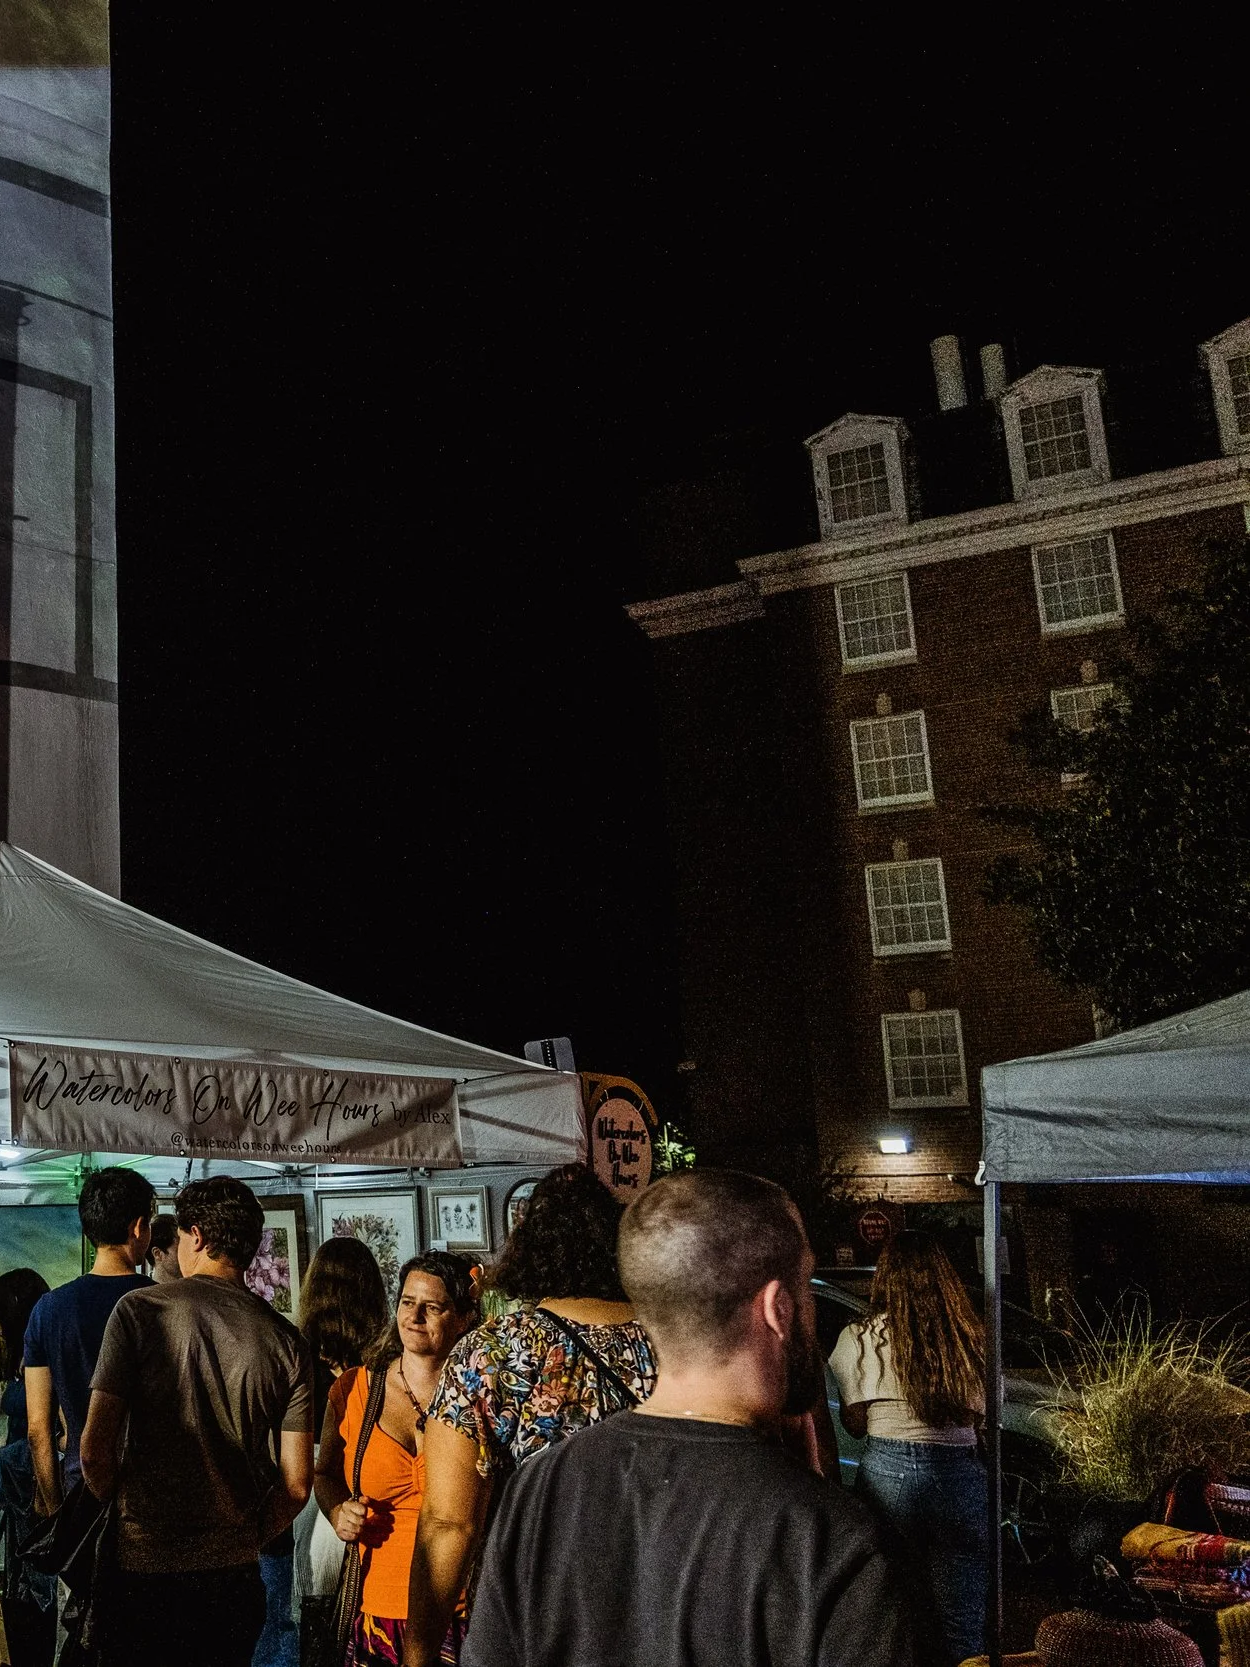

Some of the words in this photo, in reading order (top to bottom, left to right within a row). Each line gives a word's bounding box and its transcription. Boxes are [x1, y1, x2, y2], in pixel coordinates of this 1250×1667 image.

[23, 1057, 178, 1115] Watercolors
[193, 1075, 231, 1125] On
[243, 1074, 300, 1126] Wee
[310, 1078, 382, 1140] Hours
[390, 1102, 412, 1128] by
[413, 1107, 451, 1125] Alex
[171, 1132, 341, 1153] @watercolorsonweehours
